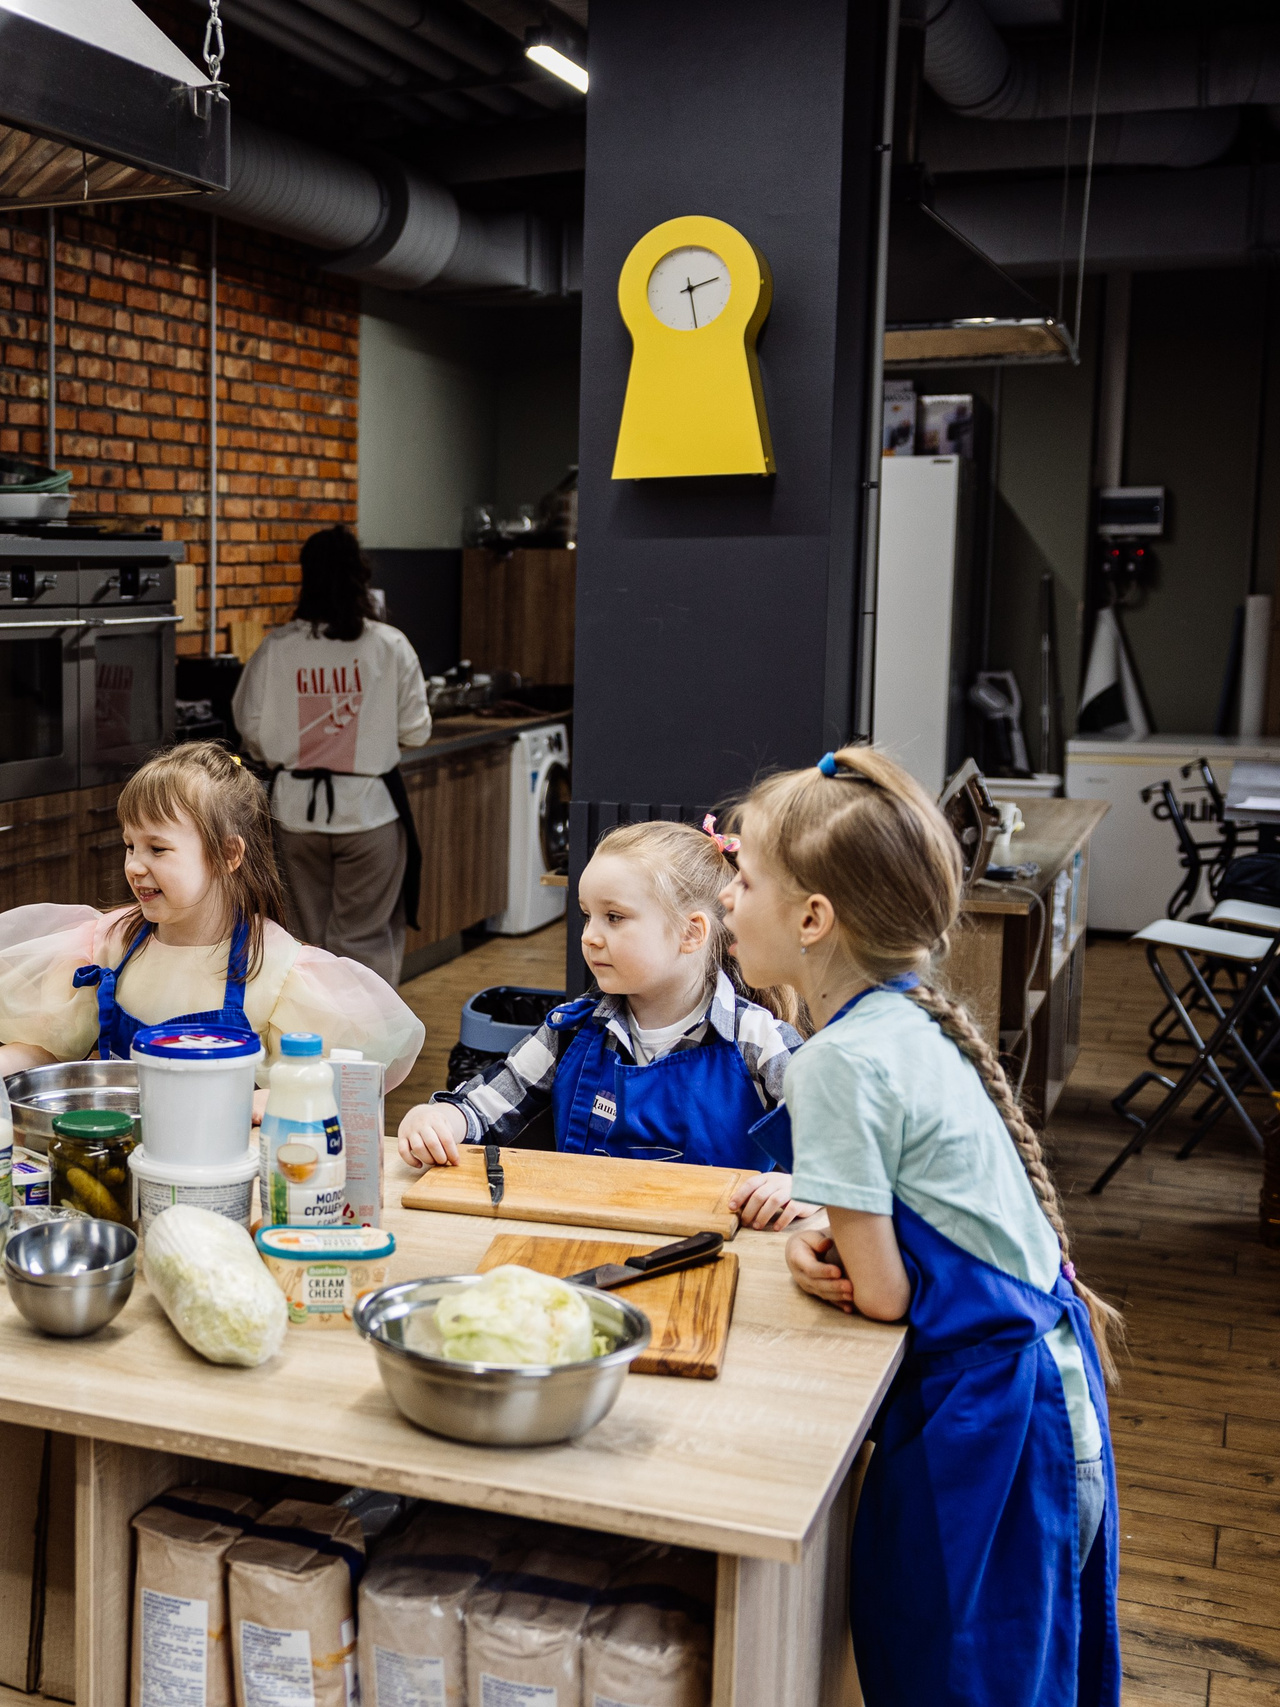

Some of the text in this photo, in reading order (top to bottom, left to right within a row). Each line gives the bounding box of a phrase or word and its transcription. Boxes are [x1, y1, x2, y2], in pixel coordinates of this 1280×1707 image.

[316, 1190, 343, 1205] МОЛО
[308, 1279, 345, 1288] CREAM
[308, 1289, 344, 1298] CHEESE
